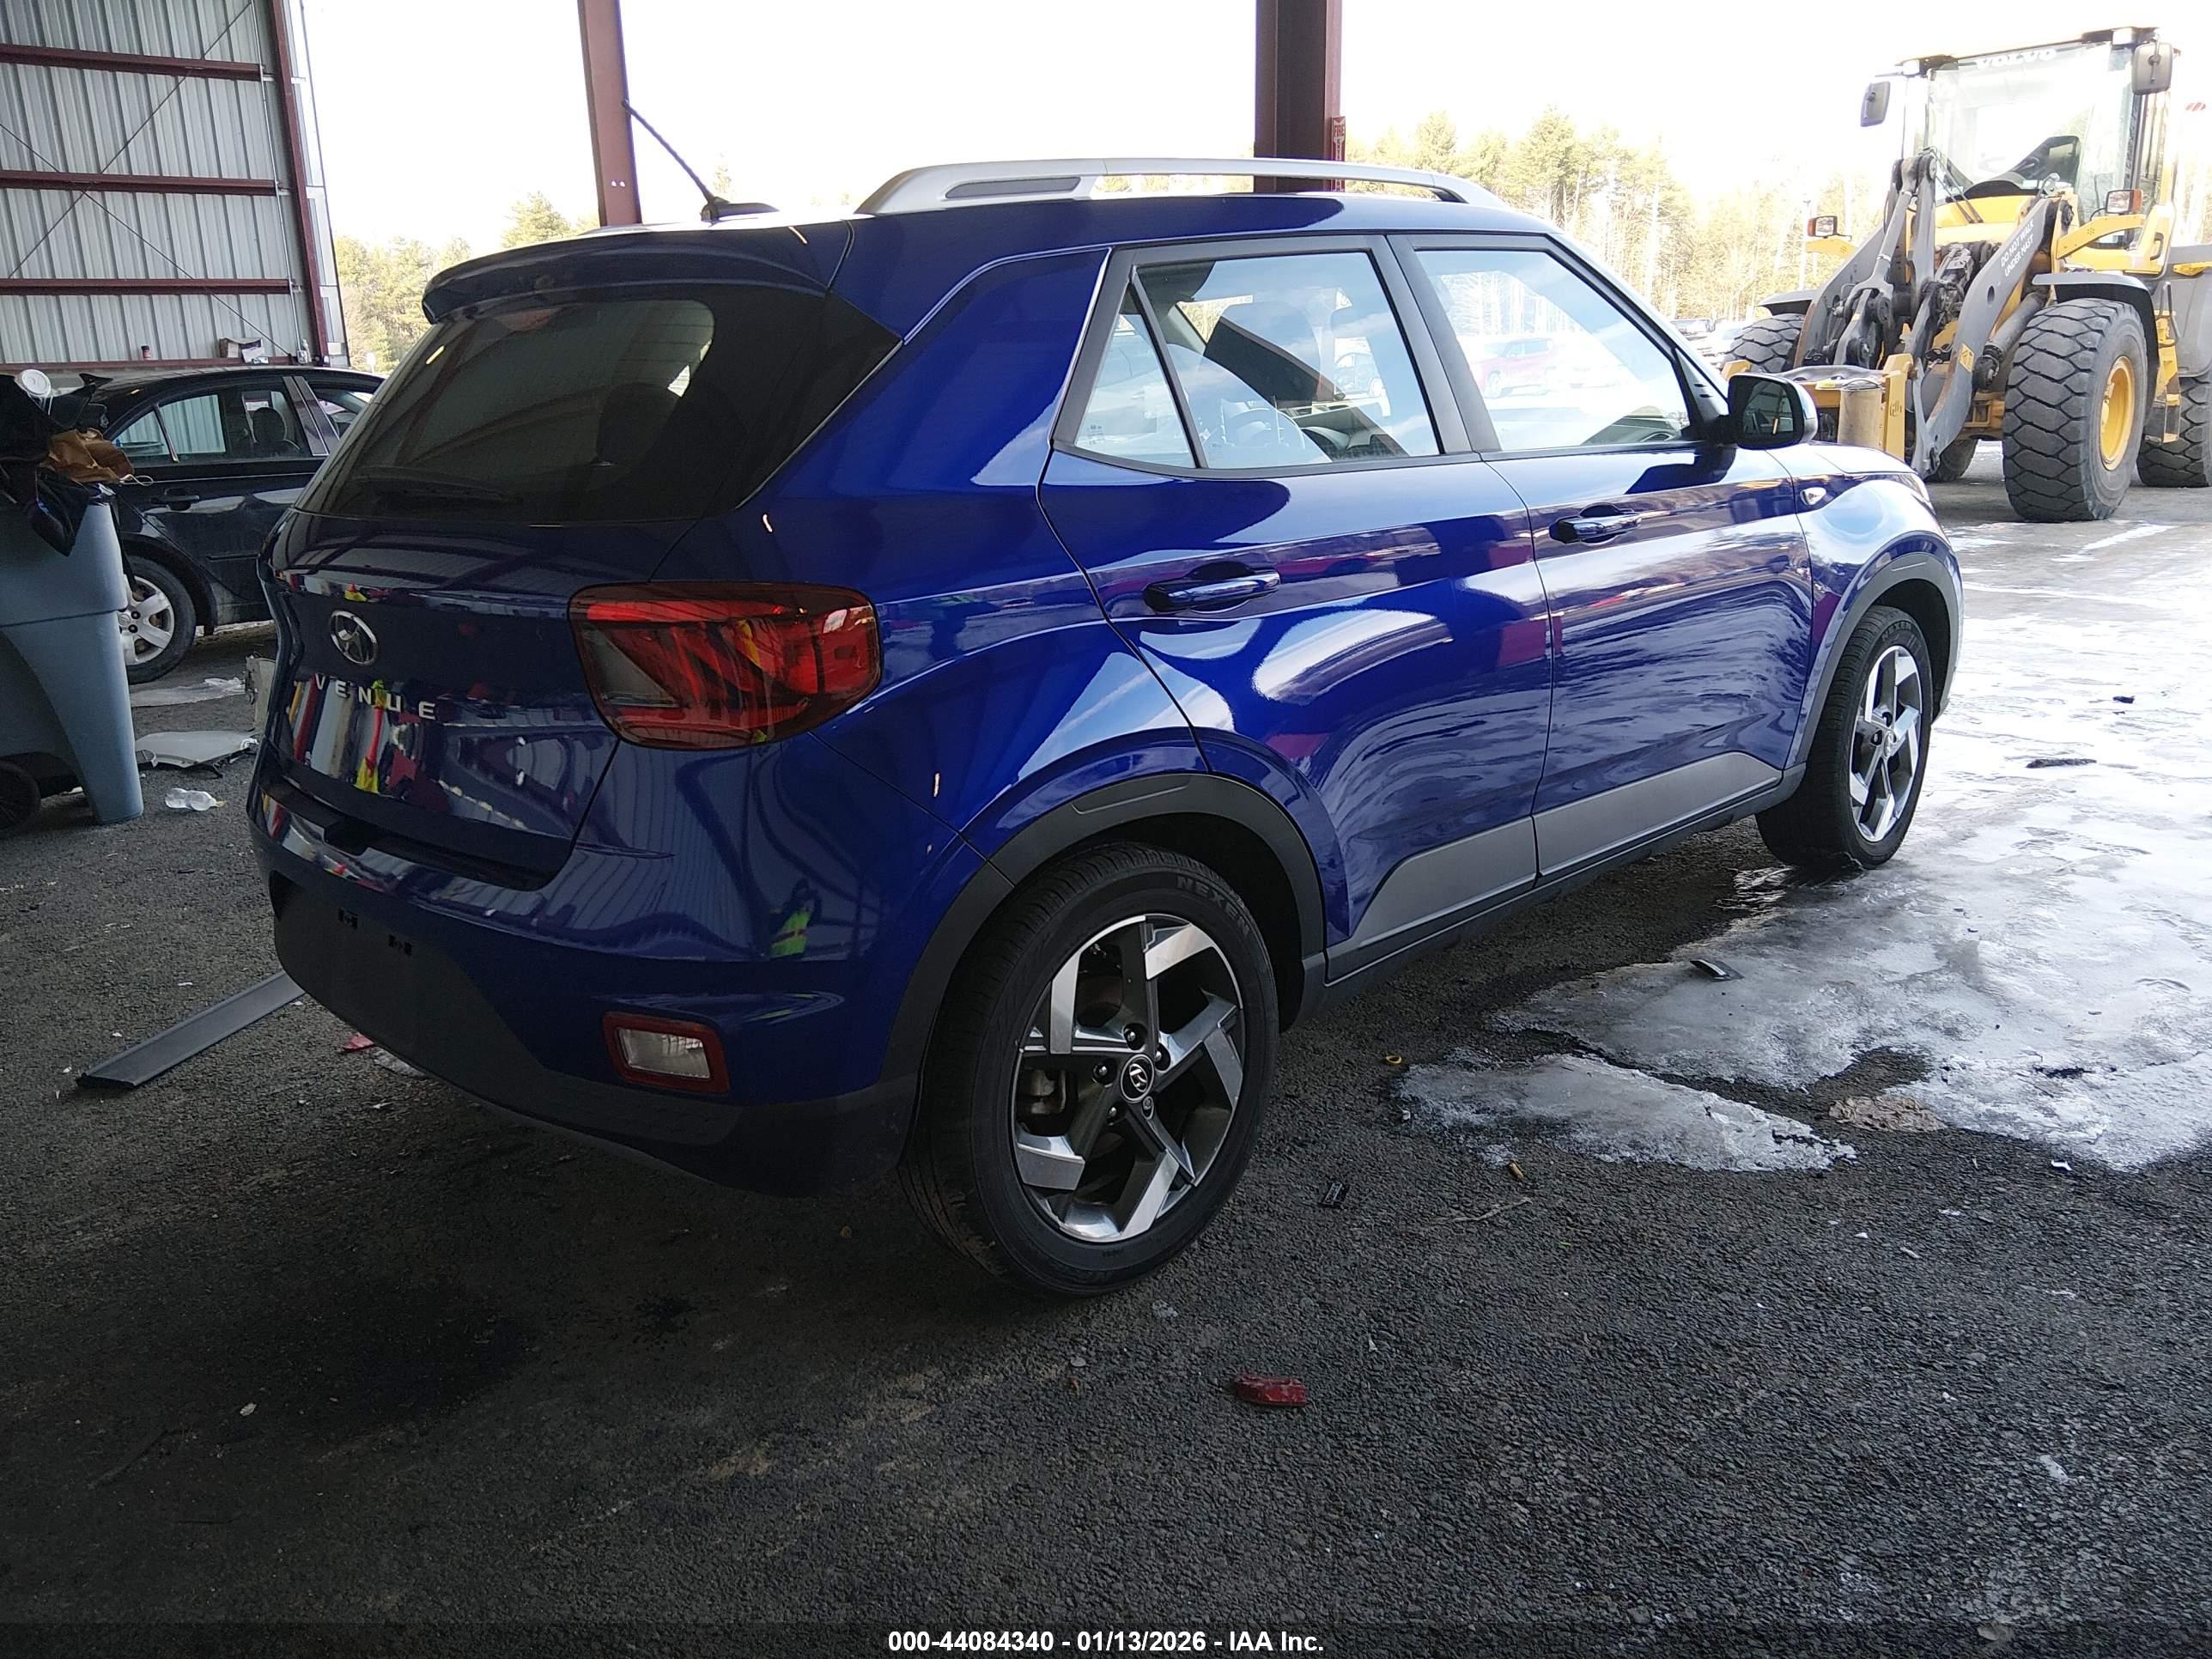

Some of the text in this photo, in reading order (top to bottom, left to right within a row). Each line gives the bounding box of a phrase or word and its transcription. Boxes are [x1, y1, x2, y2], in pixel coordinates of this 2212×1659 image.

[1975, 47, 2057, 70] VOLVO
[2001, 218, 2034, 268] DO NOT WALK
[2004, 233, 2034, 277] UNDER MAST
[1881, 621, 1912, 641] NEXEN
[314, 672, 436, 720] VENUE
[1175, 874, 1250, 939] NEXEN
